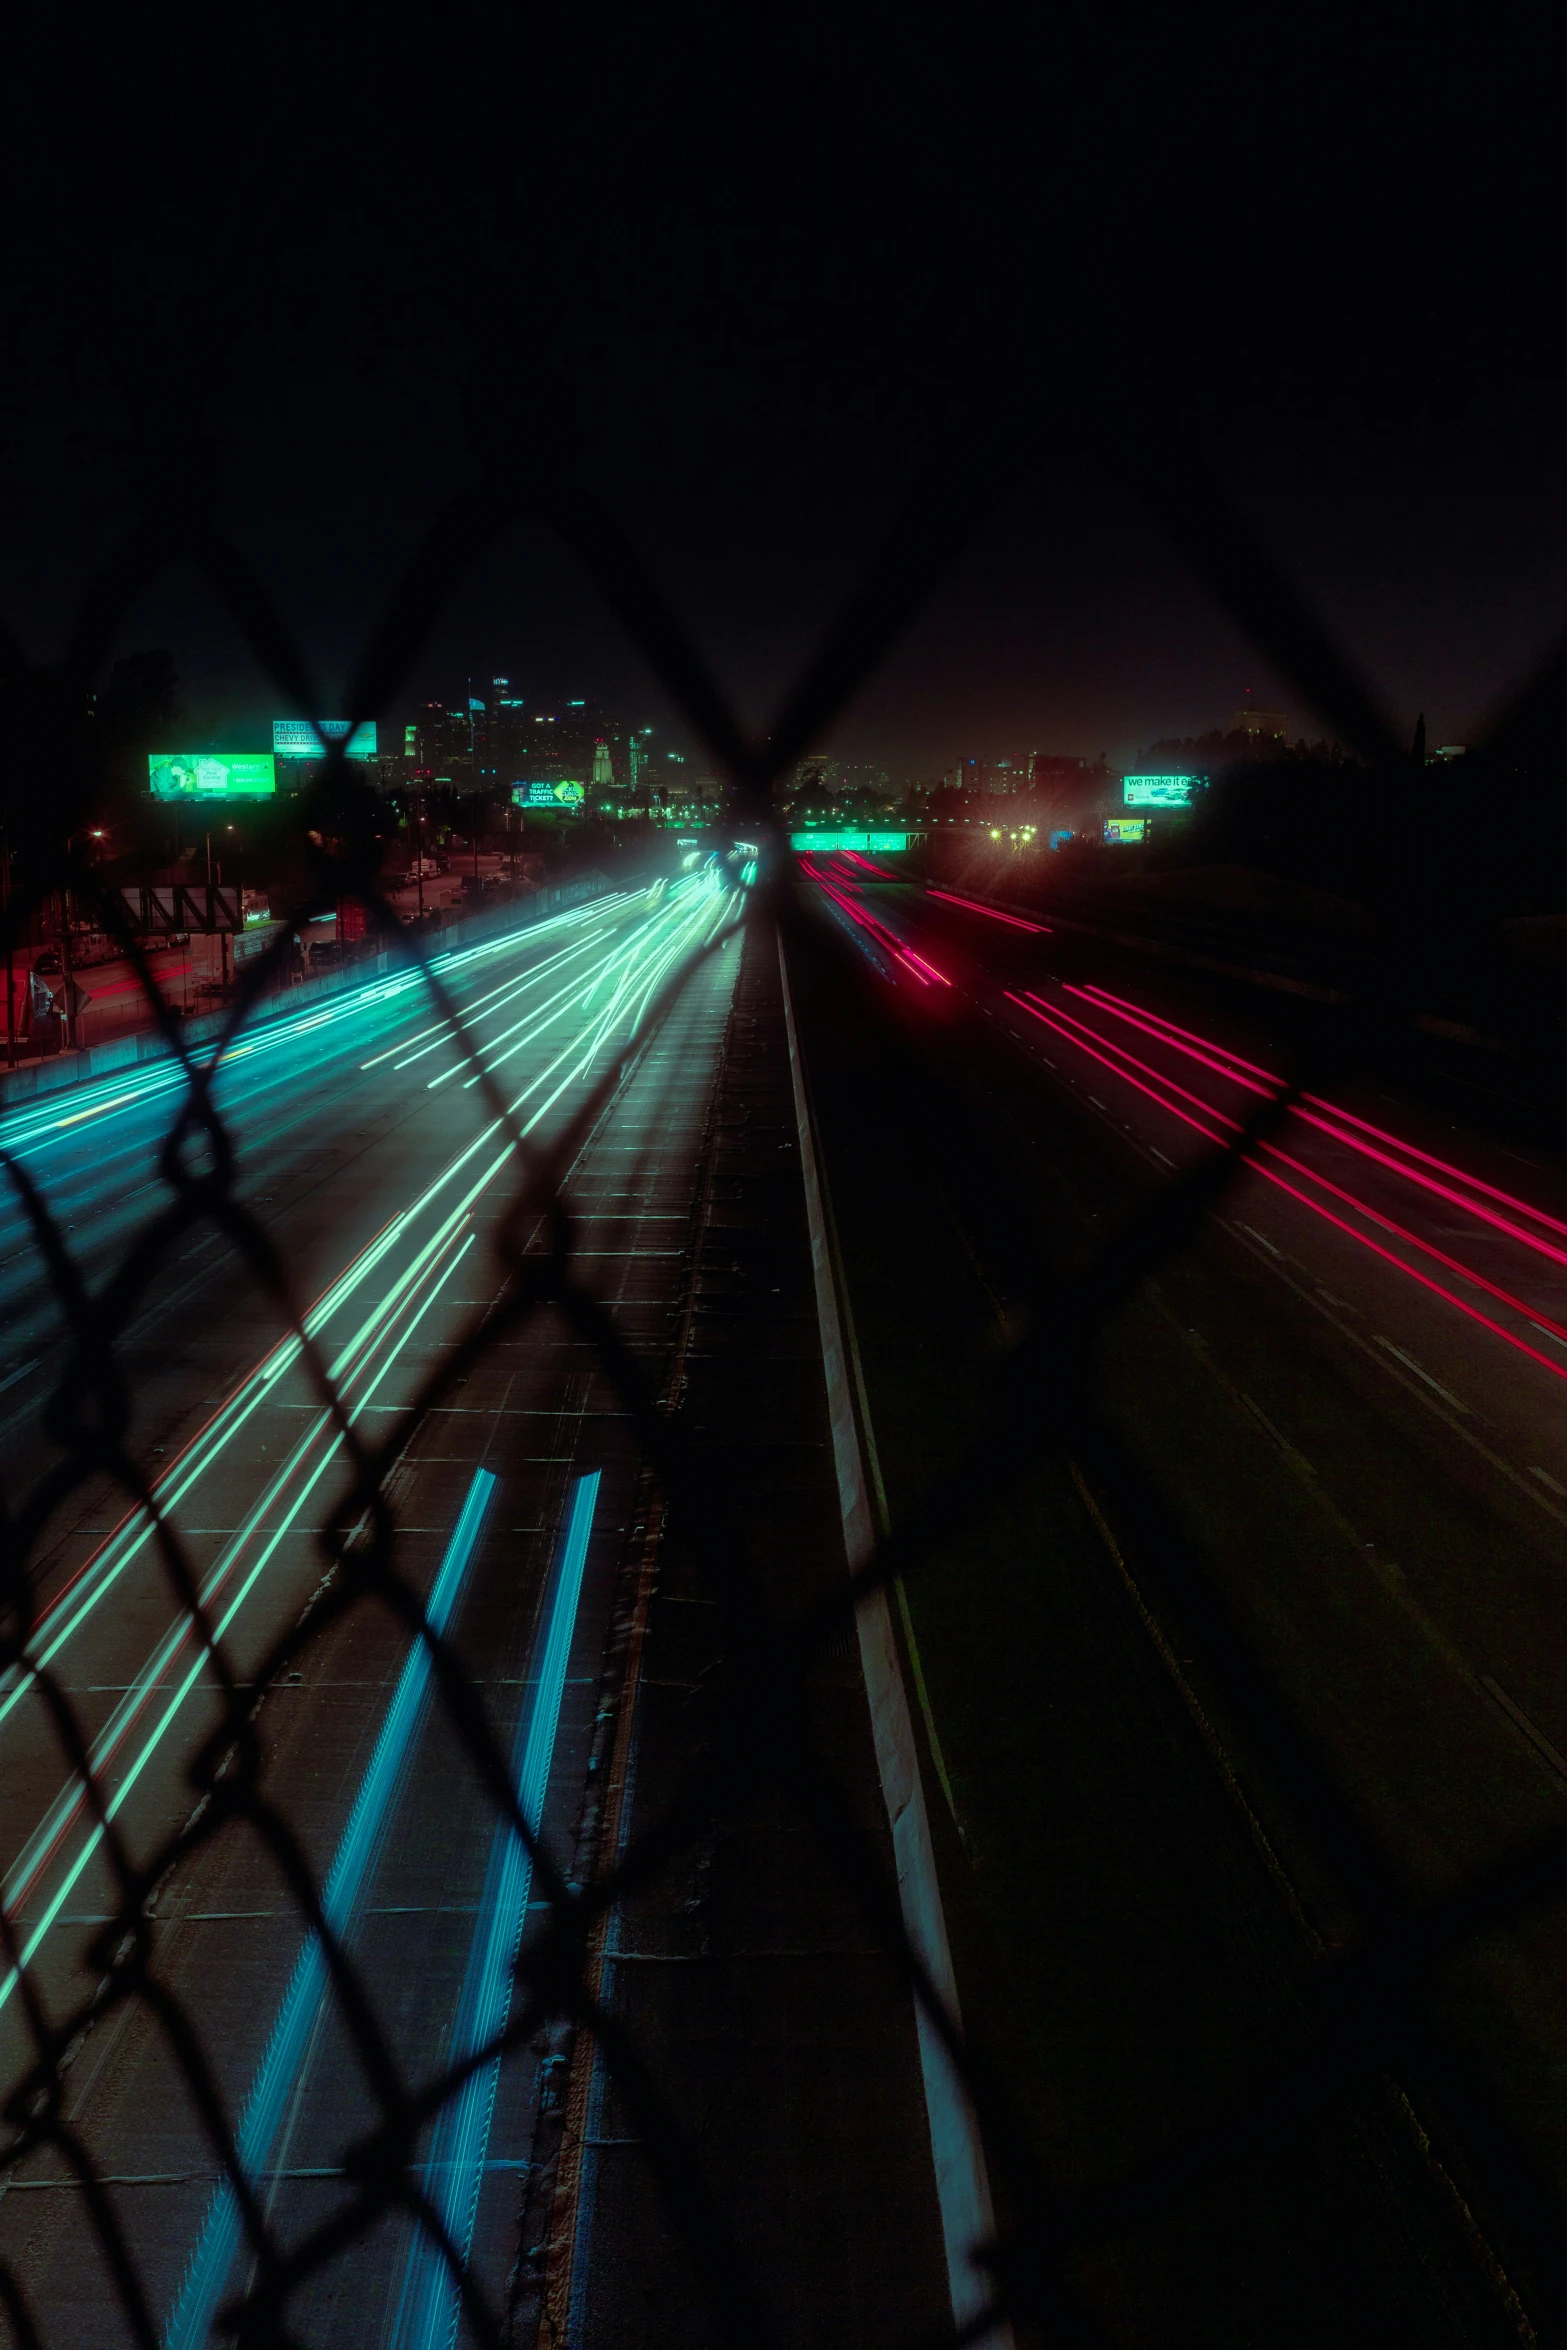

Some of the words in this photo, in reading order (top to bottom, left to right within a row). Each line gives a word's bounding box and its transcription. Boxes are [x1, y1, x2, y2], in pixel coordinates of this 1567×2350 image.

[274, 723, 327, 731] PRESIDES
[329, 723, 346, 731] DAY
[274, 734, 298, 742] CHEVY
[1128, 778, 1143, 786] we
[1144, 776, 1172, 786] make
[1173, 776, 1180, 786] it
